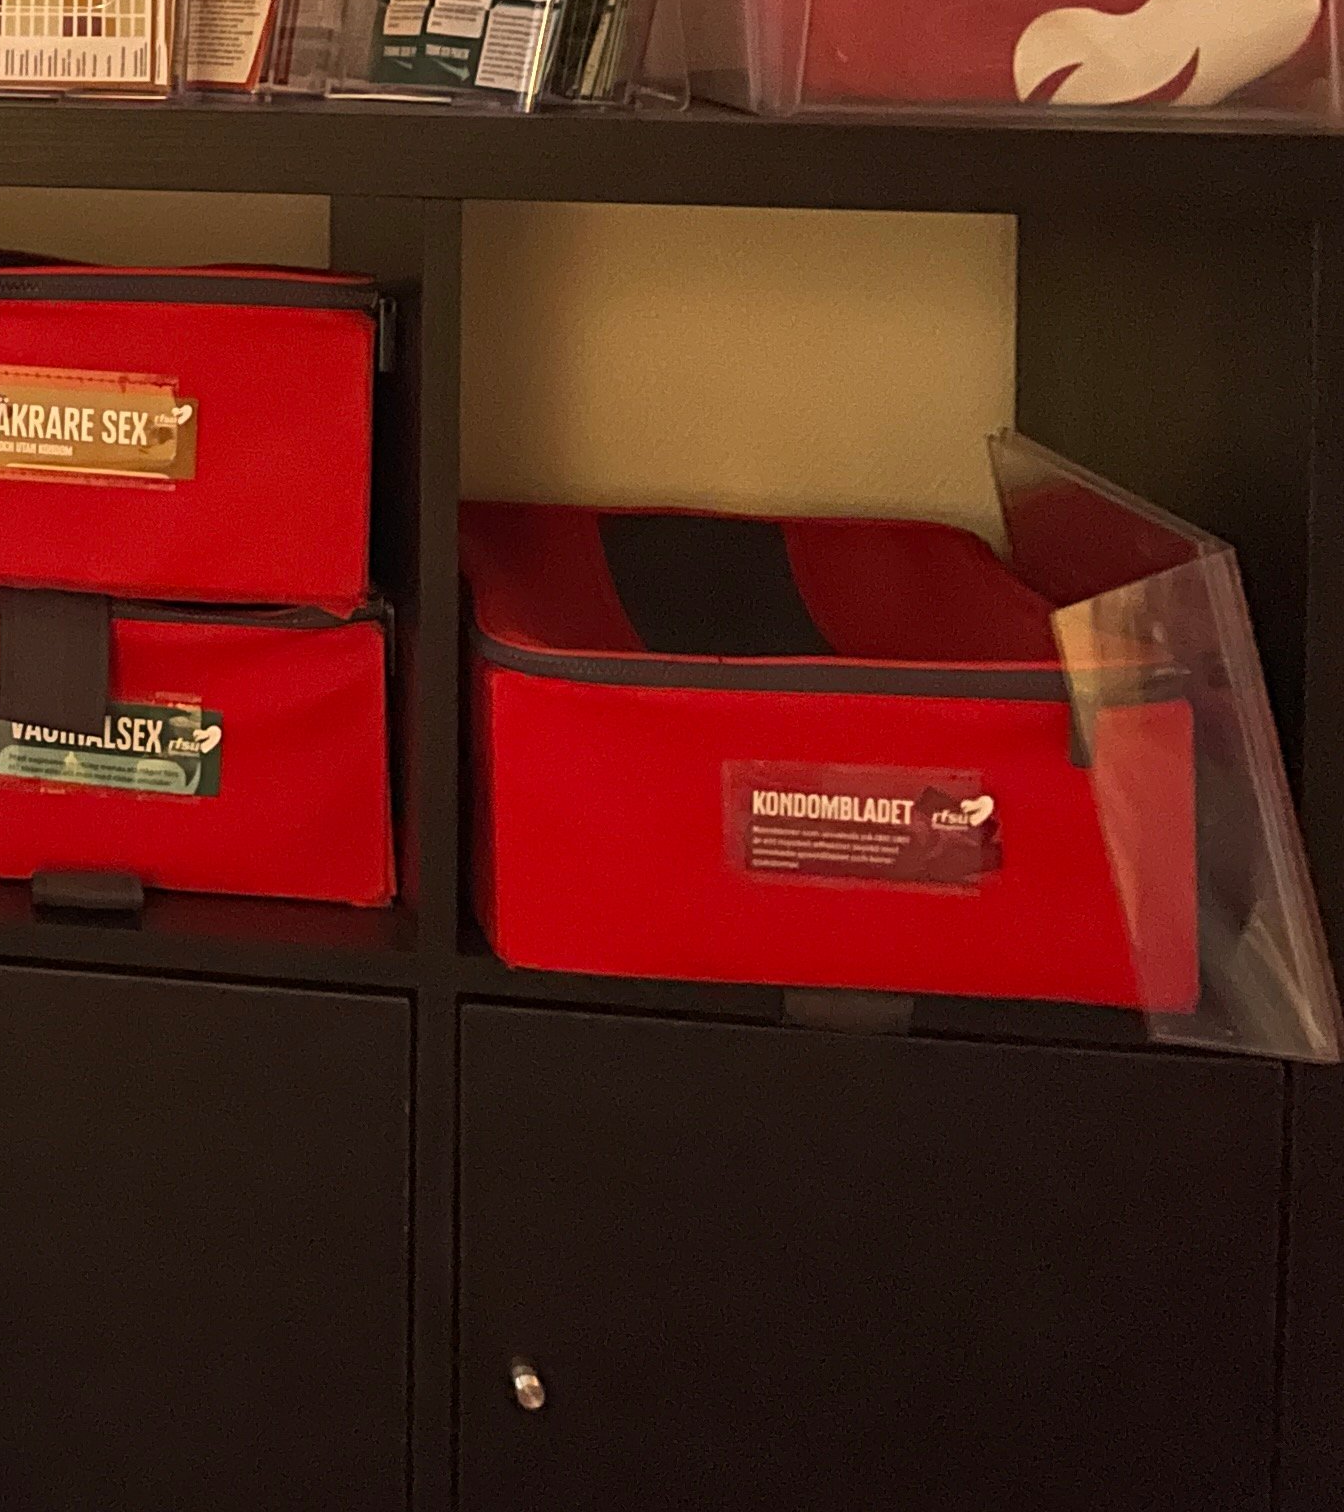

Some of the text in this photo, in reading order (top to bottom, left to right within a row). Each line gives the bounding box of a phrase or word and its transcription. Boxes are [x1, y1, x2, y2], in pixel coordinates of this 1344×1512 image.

[101, 410, 148, 446] SEX
[752, 790, 970, 825] KONDOMBLADET rfsu
